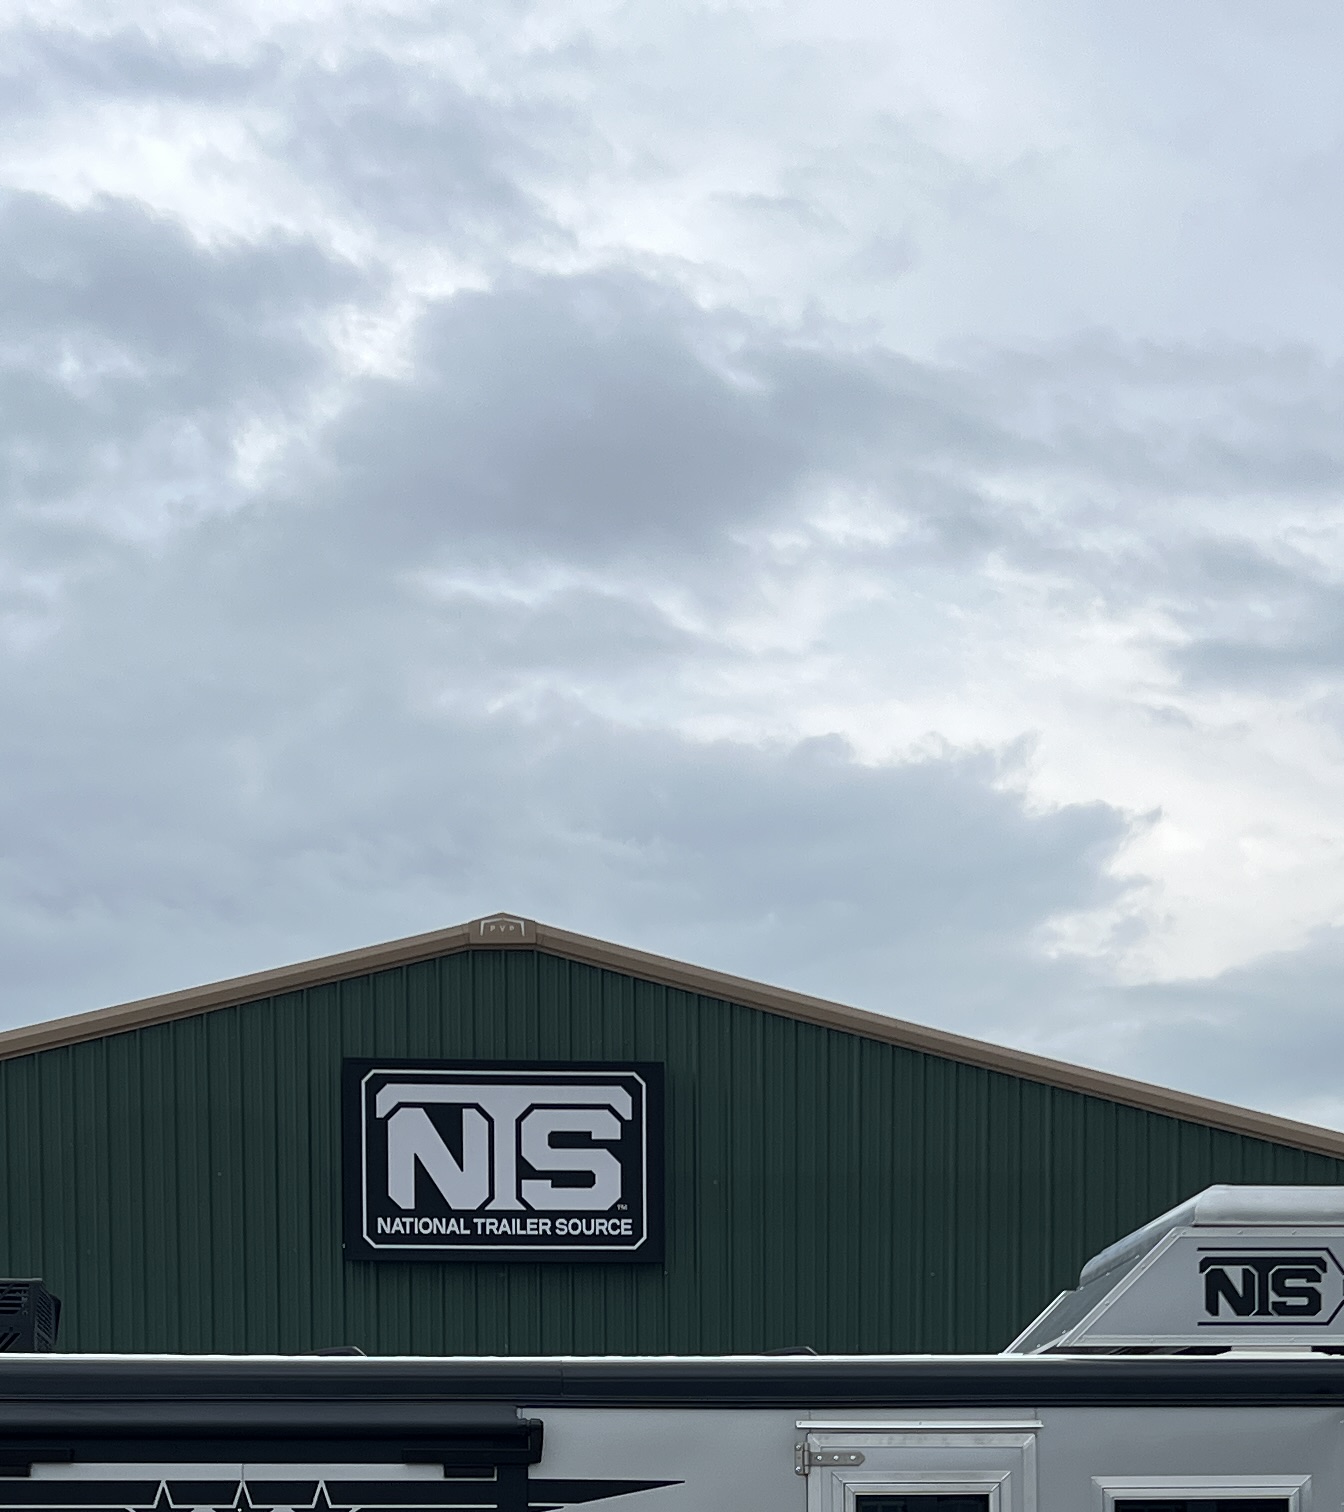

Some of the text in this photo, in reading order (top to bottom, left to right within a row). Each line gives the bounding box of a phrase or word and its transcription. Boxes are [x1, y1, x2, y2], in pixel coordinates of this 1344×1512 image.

[375, 1083, 633, 1211] NTS
[377, 1217, 633, 1236] NATIONAL TRAILER SOURCE
[1199, 1256, 1327, 1316] NTS
